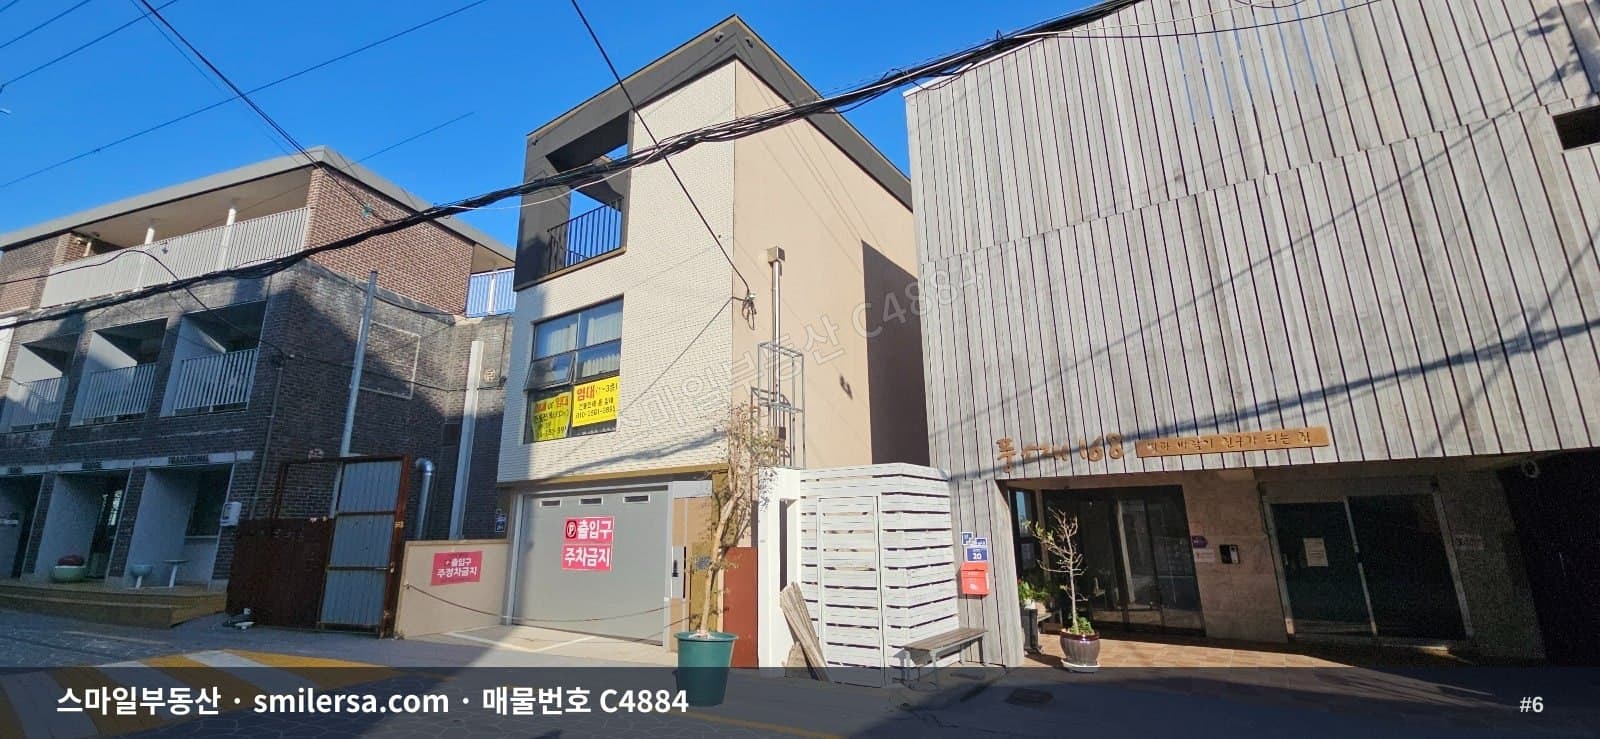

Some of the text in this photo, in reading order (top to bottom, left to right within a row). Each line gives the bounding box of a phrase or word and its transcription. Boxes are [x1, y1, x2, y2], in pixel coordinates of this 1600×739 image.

[576, 385, 596, 401] 임대
[1265, 432, 1289, 446] 되는
[577, 519, 613, 540] 출입구
[451, 557, 472, 568] 출입구
[564, 546, 611, 567] 주차금지
[436, 566, 478, 578] 주정차금지
